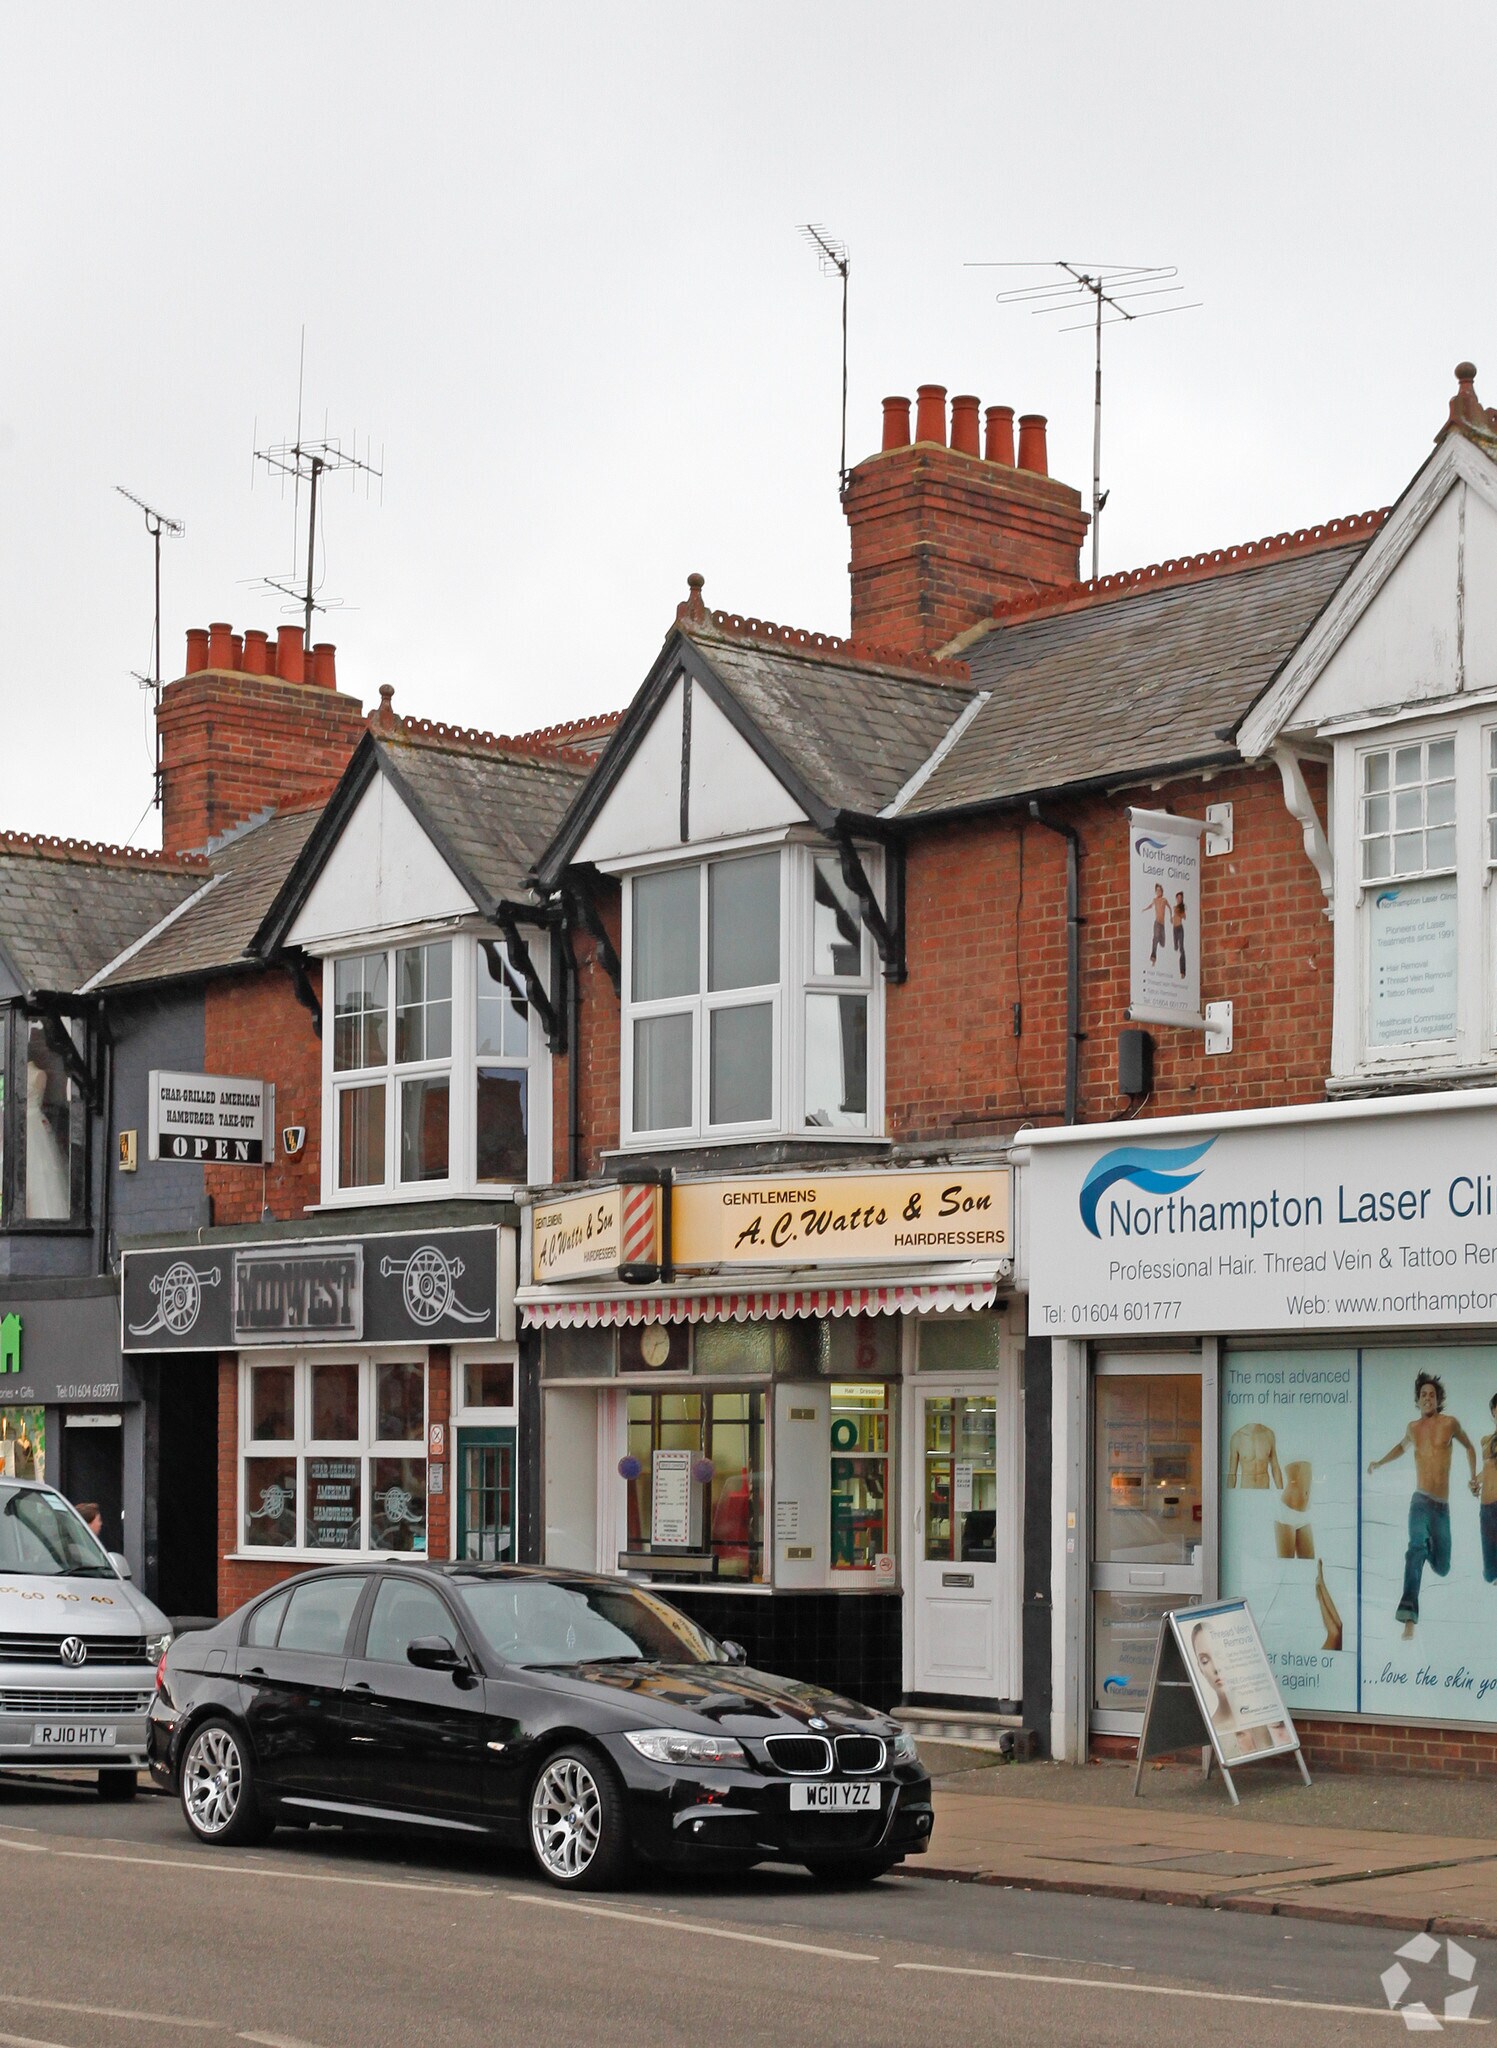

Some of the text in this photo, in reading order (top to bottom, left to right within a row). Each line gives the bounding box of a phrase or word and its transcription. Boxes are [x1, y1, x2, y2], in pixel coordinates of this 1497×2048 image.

[1142, 847, 1196, 866] Northampton
[1142, 864, 1190, 881] Laser Clinic
[1381, 893, 1457, 909] Northampton Laser Clinic
[1386, 920, 1446, 935] Pioneers of Laser
[1377, 930, 1454, 946] Treatments since 1991
[1386, 960, 1428, 971] Hair Removal
[1387, 970, 1453, 984] Thread Vein Removal
[1387, 986, 1434, 997] Tattoo Removal
[1376, 1012, 1456, 1028] Healthcare Commission
[1379, 1027, 1412, 1039] registered
[1420, 1023, 1452, 1034] regulated
[161, 1088, 260, 1107] CHAR-GRILLED AMERICAN
[166, 1110, 255, 1128] HAMBURGER TAKE-OUT
[173, 1136, 249, 1161] OPEN
[723, 1189, 816, 1206] GENTLEMENS
[903, 1193, 922, 1221] &
[938, 1186, 992, 1217] Son
[1110, 1175, 1497, 1238] Northampton Laser Cli
[535, 1213, 562, 1229] GENTLEMENS
[586, 1213, 593, 1239] &
[597, 1206, 613, 1235] Son
[895, 1230, 1005, 1247] HAIRDRESSERS
[584, 1246, 616, 1262] HAIRDRESSERS
[1110, 1257, 1212, 1281] Professional
[1219, 1254, 1256, 1275] Hair.
[1263, 1250, 1326, 1273] Thread
[1333, 1249, 1372, 1270] Vein
[1379, 1247, 1392, 1269] &
[1399, 1246, 1457, 1267] Tattoo
[1043, 1301, 1182, 1323] Tel: 01604 601777
[1287, 1295, 1330, 1315] Web:
[1230, 1369, 1350, 1384] The most advanced
[56, 1383, 119, 1397] Tel: 01604 603977
[1227, 1390, 1352, 1404] form of hair removal.
[317, 1485, 351, 1500] AMERICAN
[313, 1506, 353, 1522] HAMBURGER
[1281, 1651, 1318, 1667] shave
[1321, 1655, 1334, 1668] or
[1282, 1673, 1320, 1690] again!
[1415, 1665, 1438, 1686] the
[1444, 1666, 1473, 1690] skin
[79, 1728, 107, 1744] HTY
[807, 1786, 871, 1805] WG11 YZZ
